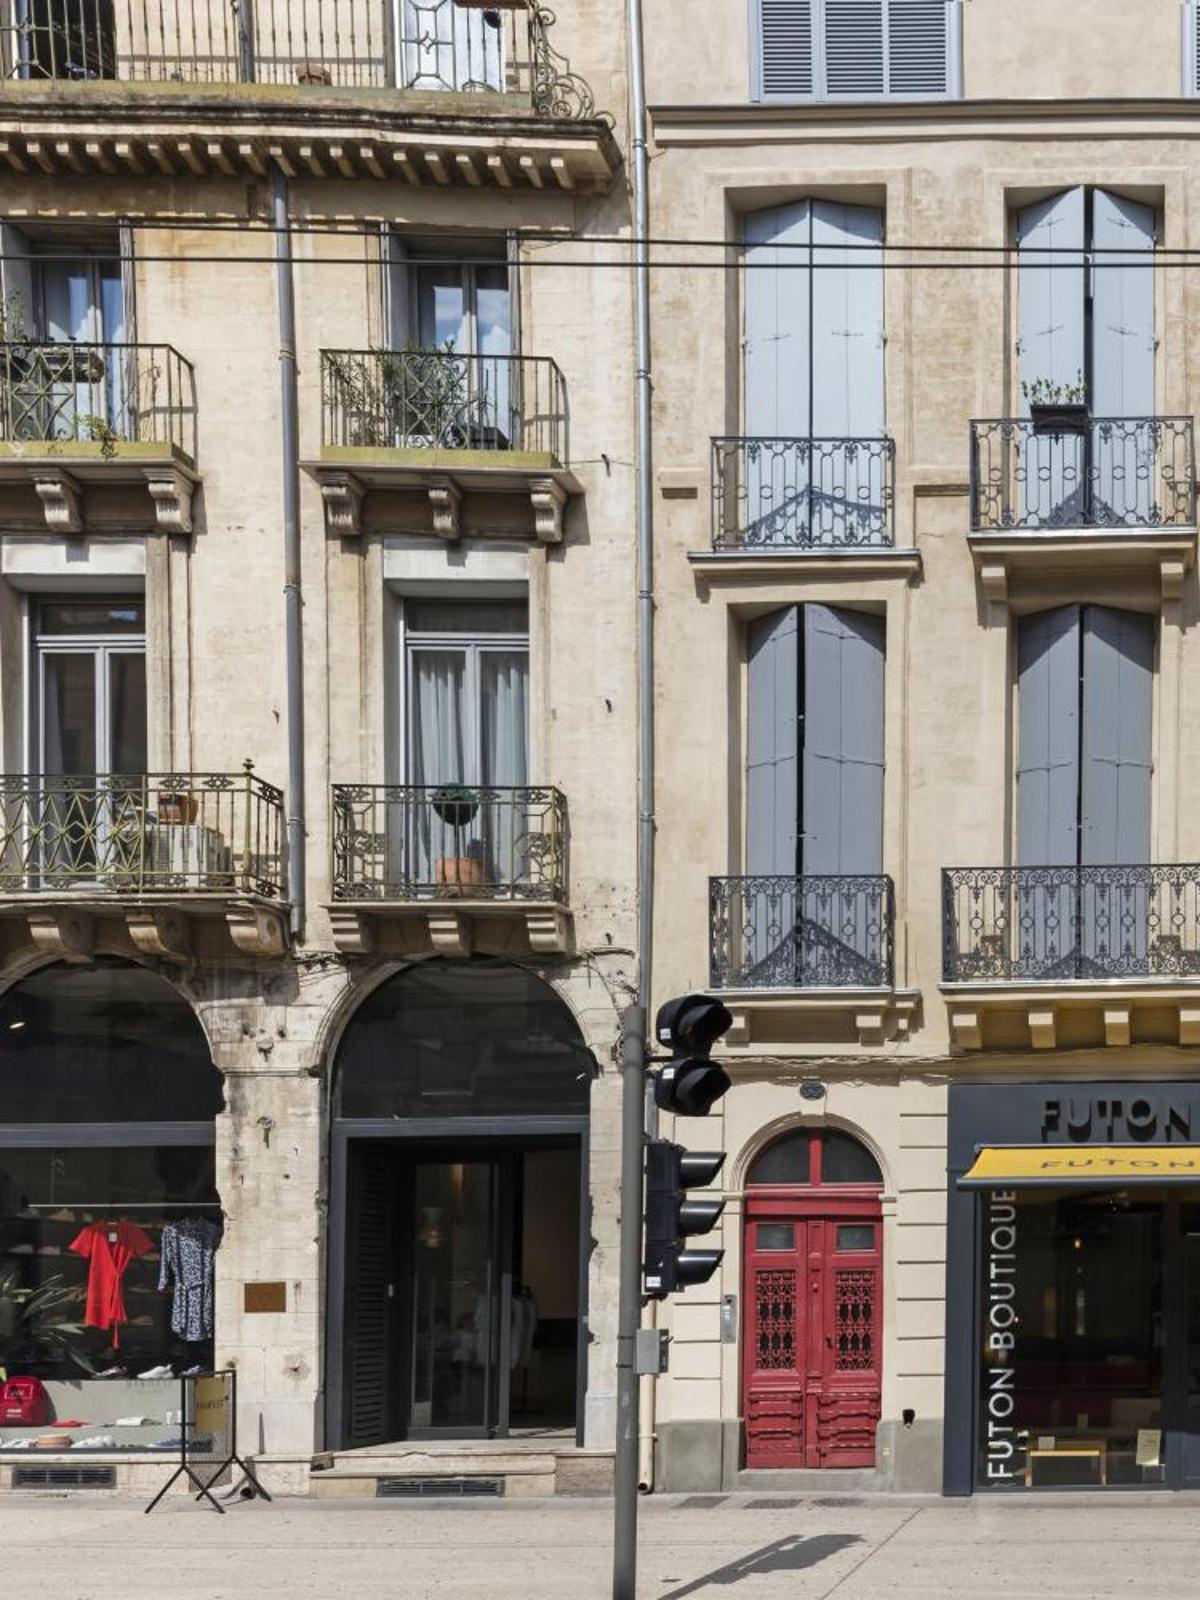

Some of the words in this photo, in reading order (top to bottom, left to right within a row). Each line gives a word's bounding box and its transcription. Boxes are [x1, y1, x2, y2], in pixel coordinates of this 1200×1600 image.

[1042, 1097, 1192, 1139] FUTON
[1041, 1158, 1195, 1169] FUTON
[989, 1190, 1017, 1350] BOUTIQUE
[987, 1368, 1015, 1478] FUTON
